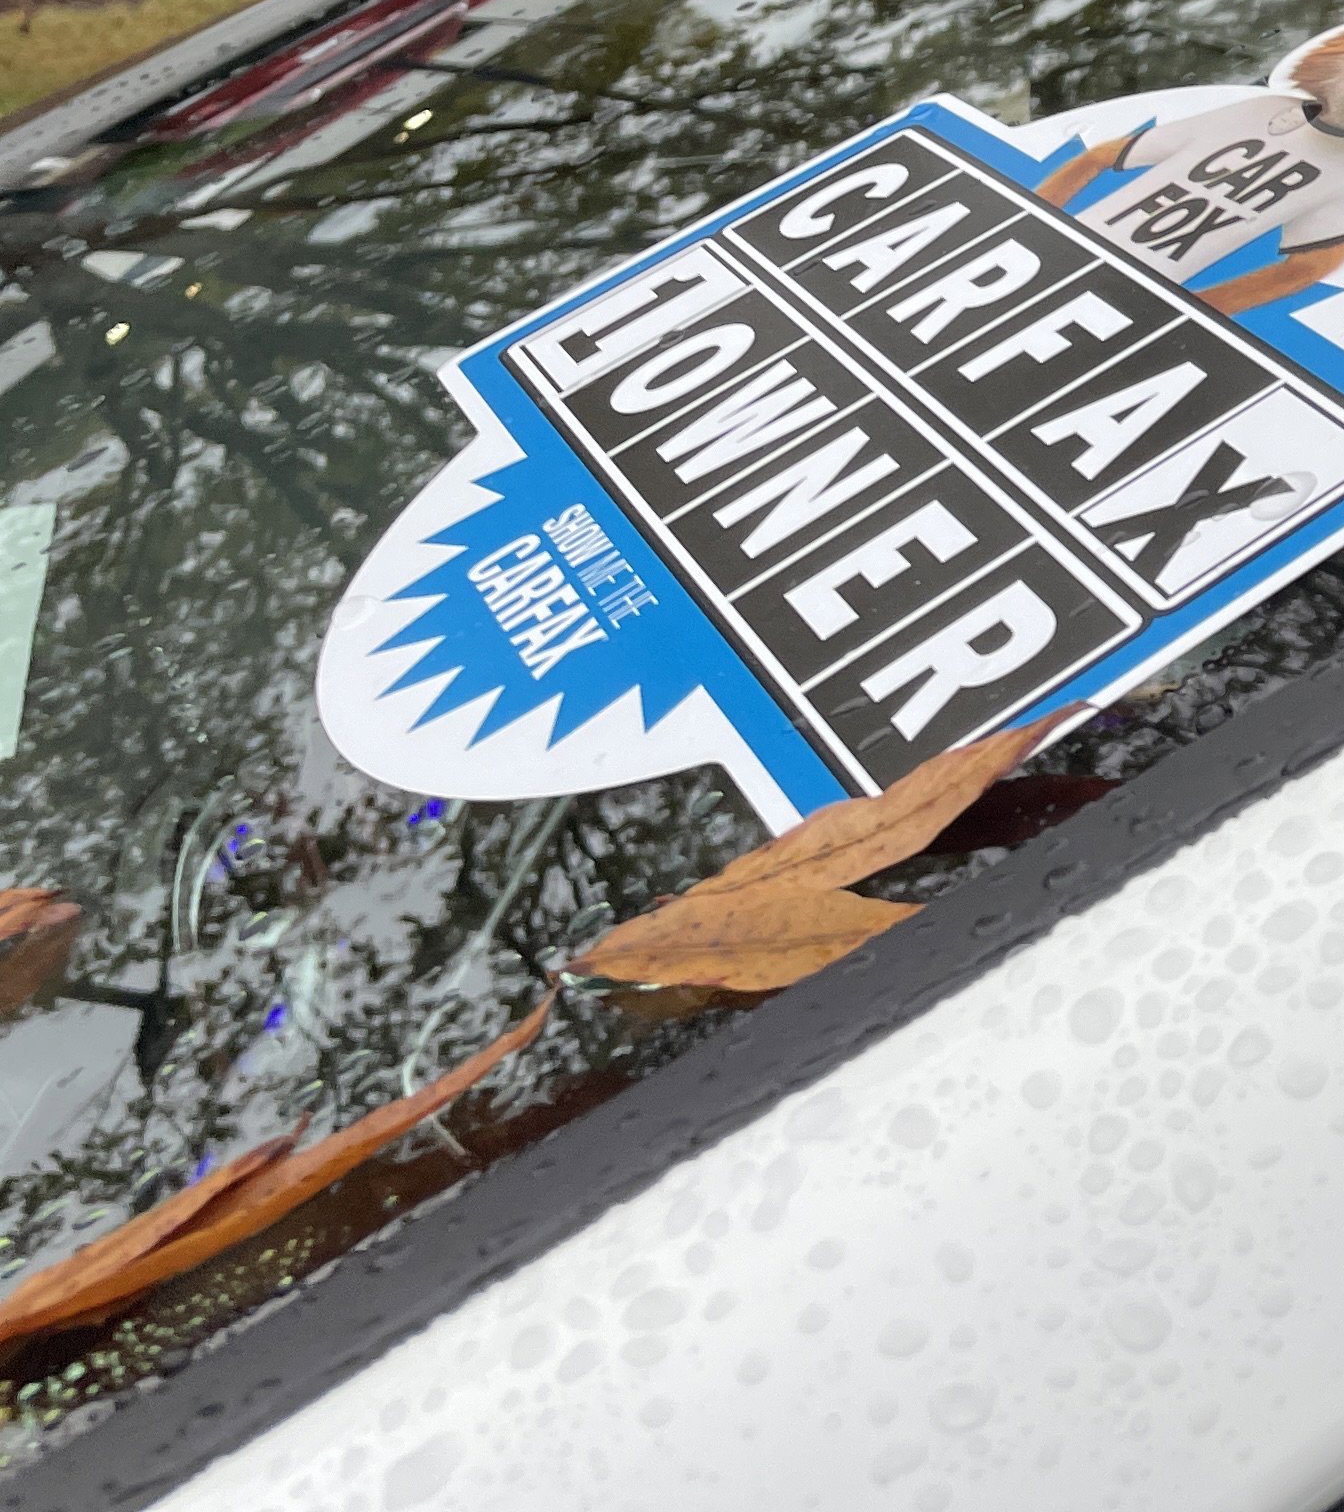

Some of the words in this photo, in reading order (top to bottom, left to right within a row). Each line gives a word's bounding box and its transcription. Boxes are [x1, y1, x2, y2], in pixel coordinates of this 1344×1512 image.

[1187, 138, 1323, 214] CAR
[1103, 182, 1246, 262] FOX
[557, 273, 708, 366] 1
[778, 161, 1297, 587] CARFAX
[541, 502, 615, 569] SHOW
[608, 321, 1059, 743] OWNER
[466, 533, 610, 681] CARFAX
[575, 548, 635, 597] ME
[597, 573, 660, 631] THE
